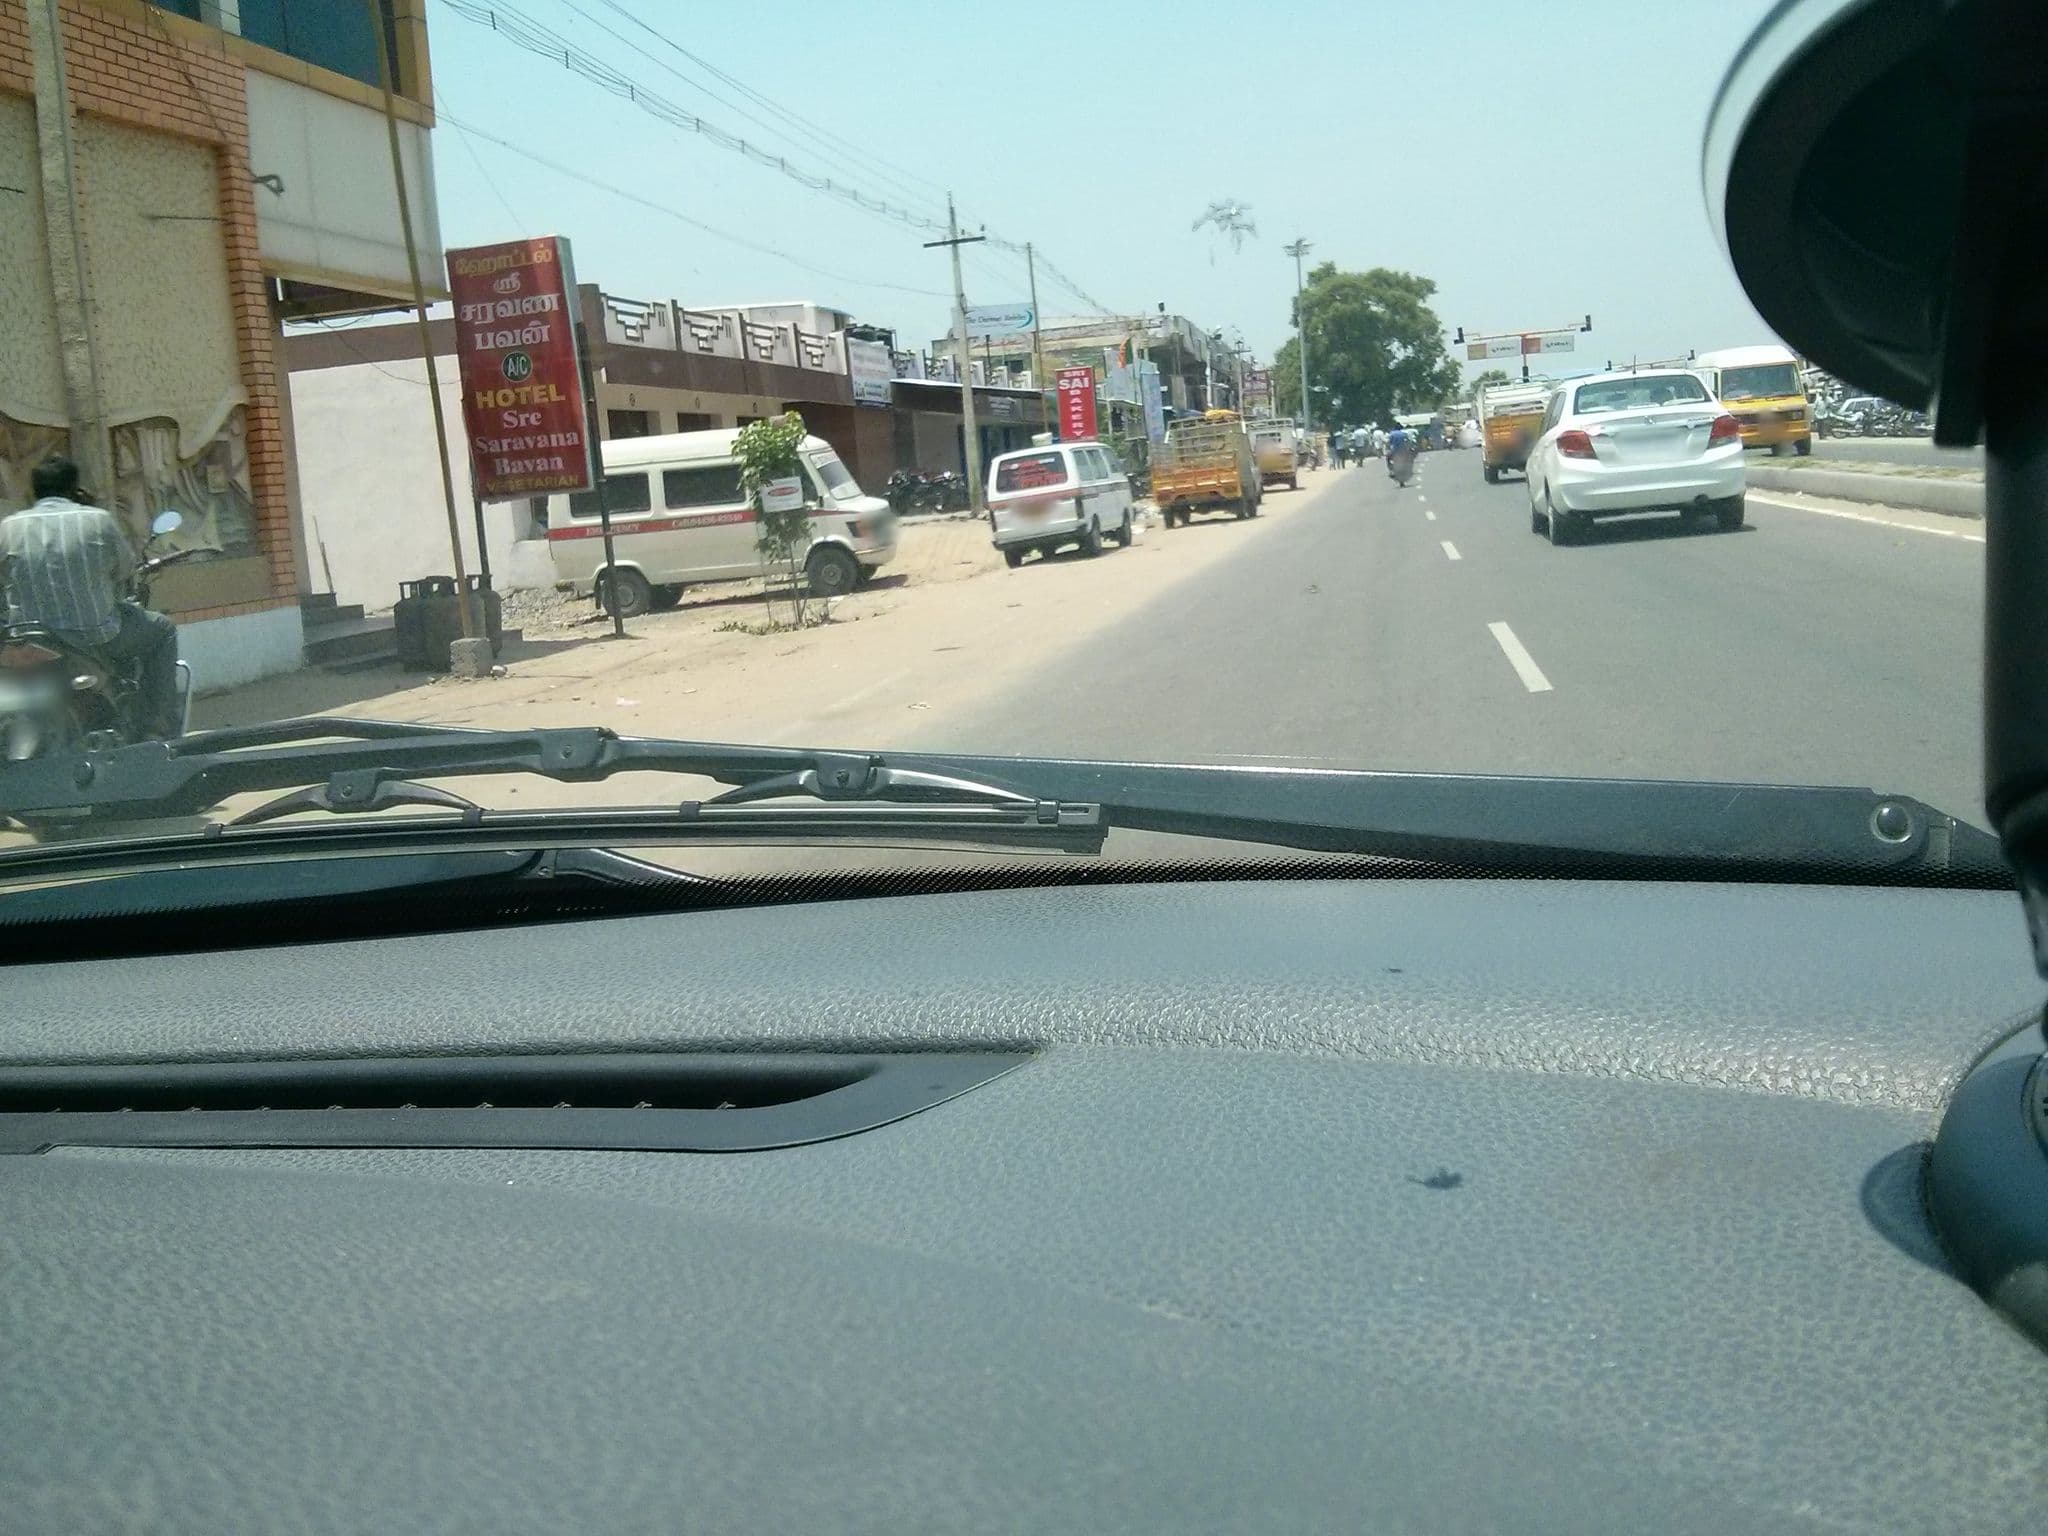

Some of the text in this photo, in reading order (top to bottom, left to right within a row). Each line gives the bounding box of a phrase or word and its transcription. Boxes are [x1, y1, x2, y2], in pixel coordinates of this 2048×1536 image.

[460, 293, 561, 325] சரவண
[474, 320, 551, 351] பவன்
[507, 355, 529, 378] A/C
[475, 383, 566, 409] HOTEL
[1059, 377, 1090, 391] SAI
[1069, 389, 1085, 437] BAKERY
[475, 431, 580, 454] Saravana
[495, 456, 565, 475] Bavan
